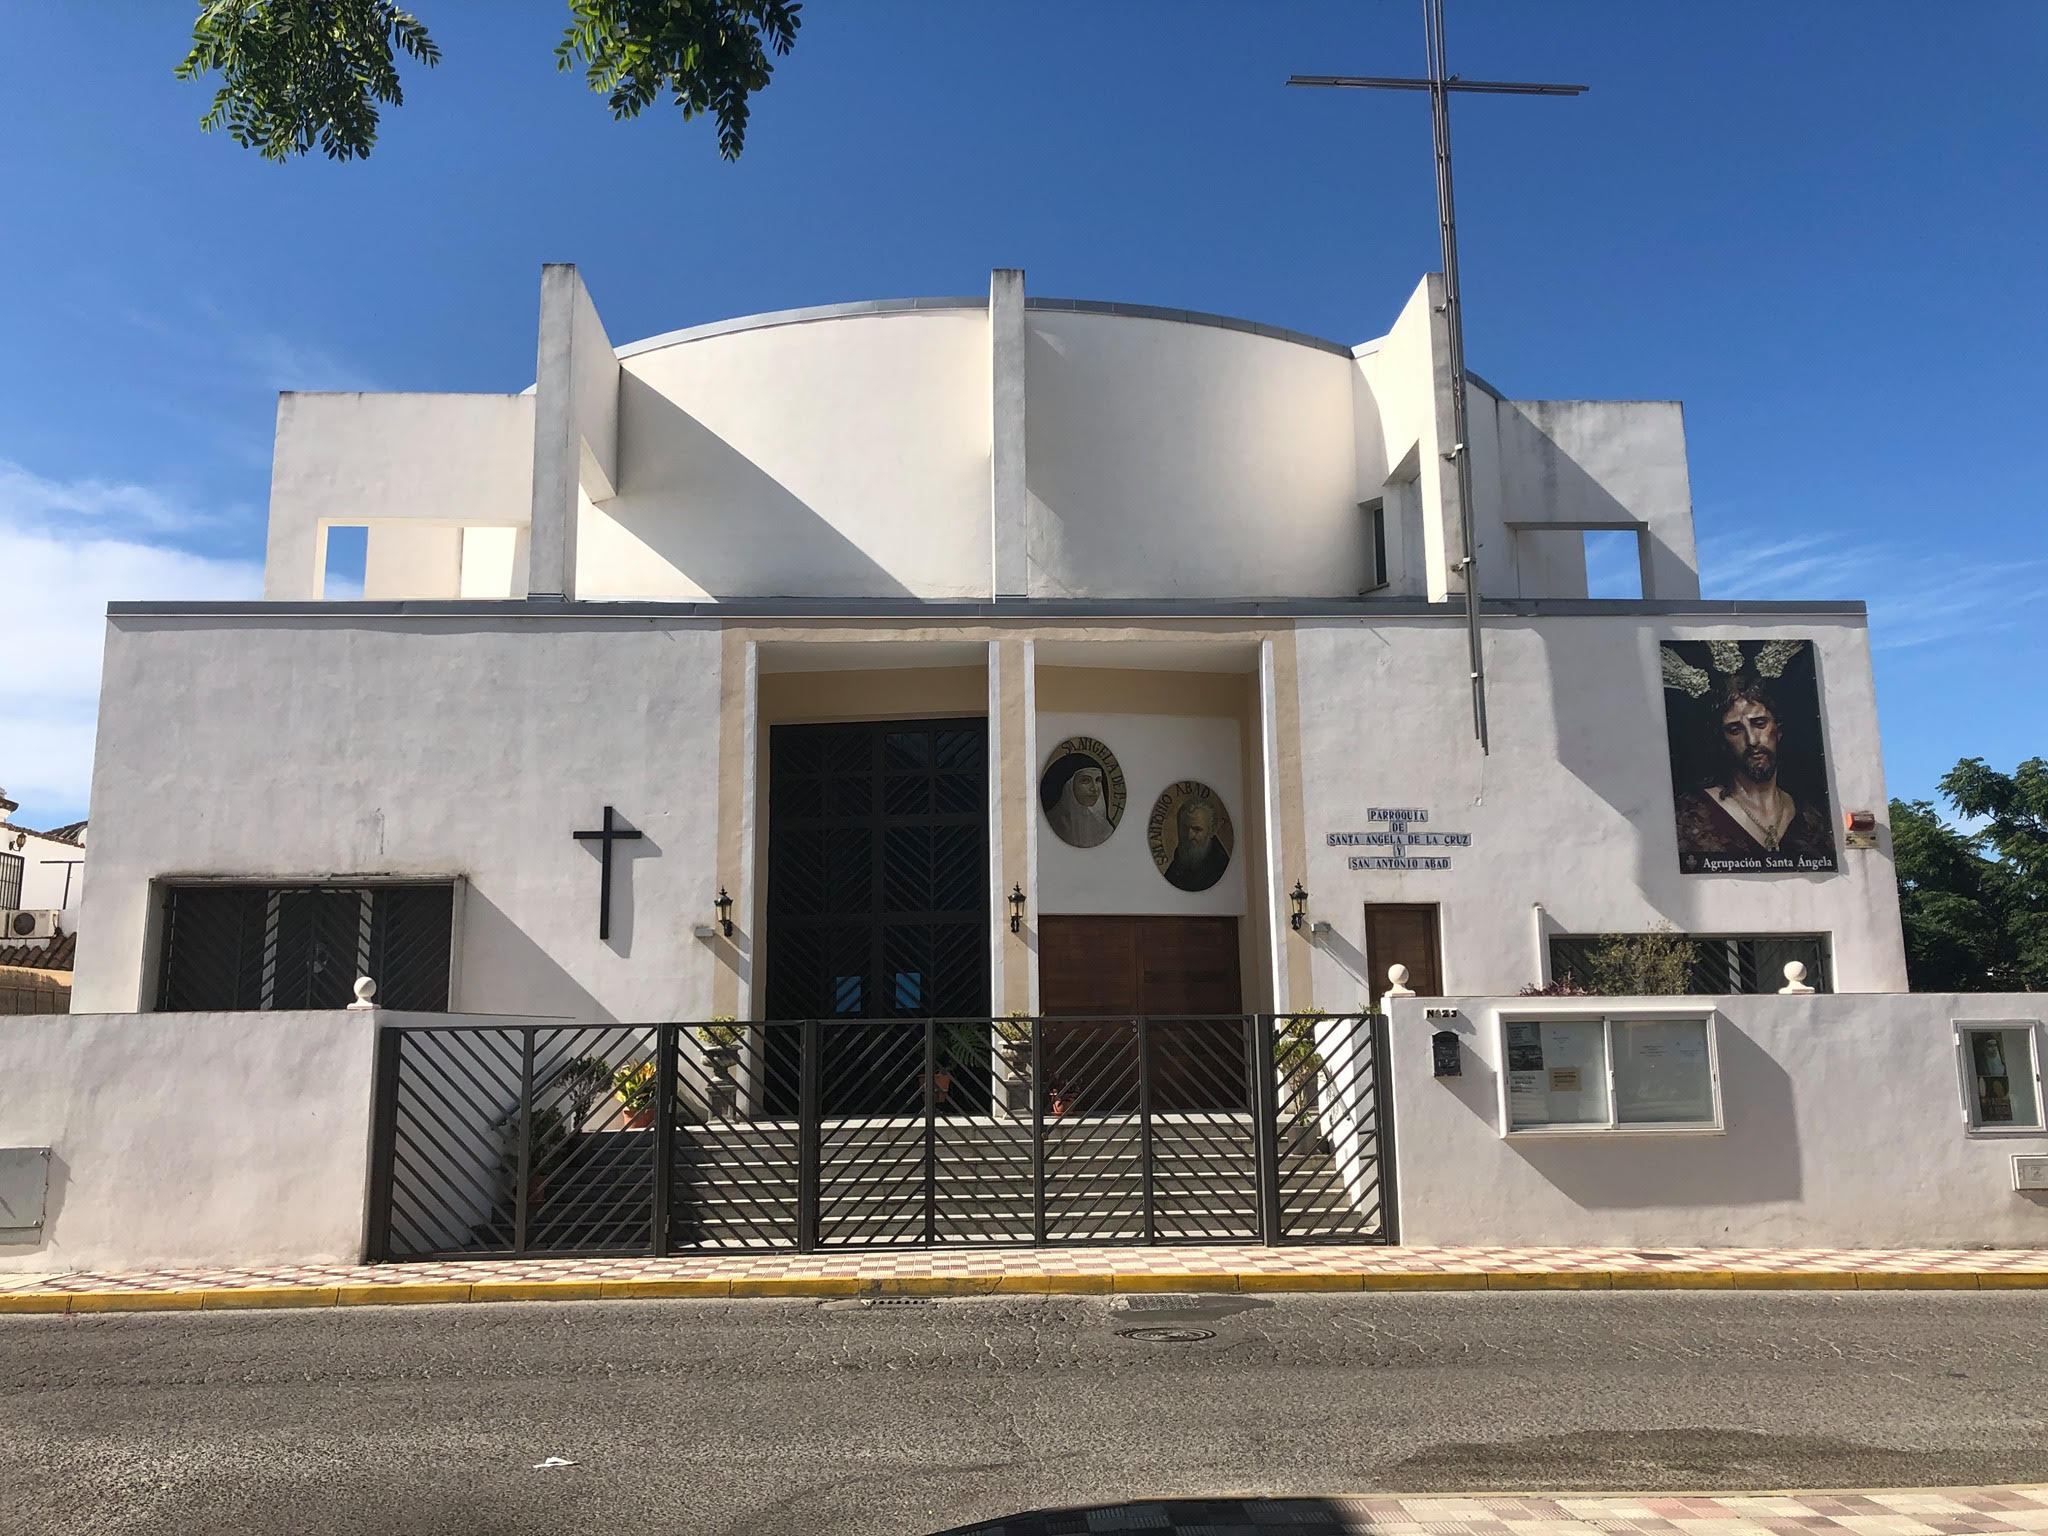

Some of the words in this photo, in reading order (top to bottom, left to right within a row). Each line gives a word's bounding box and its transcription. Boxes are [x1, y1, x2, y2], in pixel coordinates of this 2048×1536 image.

[1175, 782, 1210, 799] ABAD
[1370, 810, 1425, 820] PARROQUIA
[1392, 823, 1404, 832] DE
[1329, 835, 1360, 844] SANTA
[1366, 835, 1402, 844] ANGELA
[1408, 835, 1420, 844] DE
[1426, 835, 1438, 844] LA
[1444, 835, 1468, 844] CRUZ
[1396, 847, 1402, 856] Y
[1352, 859, 1370, 868] SAN
[1376, 859, 1418, 868] ANTONIO
[1424, 859, 1449, 868] ABAD
[1703, 857, 1762, 871] Agrupación
[1765, 857, 1794, 868] Santa
[1798, 854, 1832, 870] Ángela
